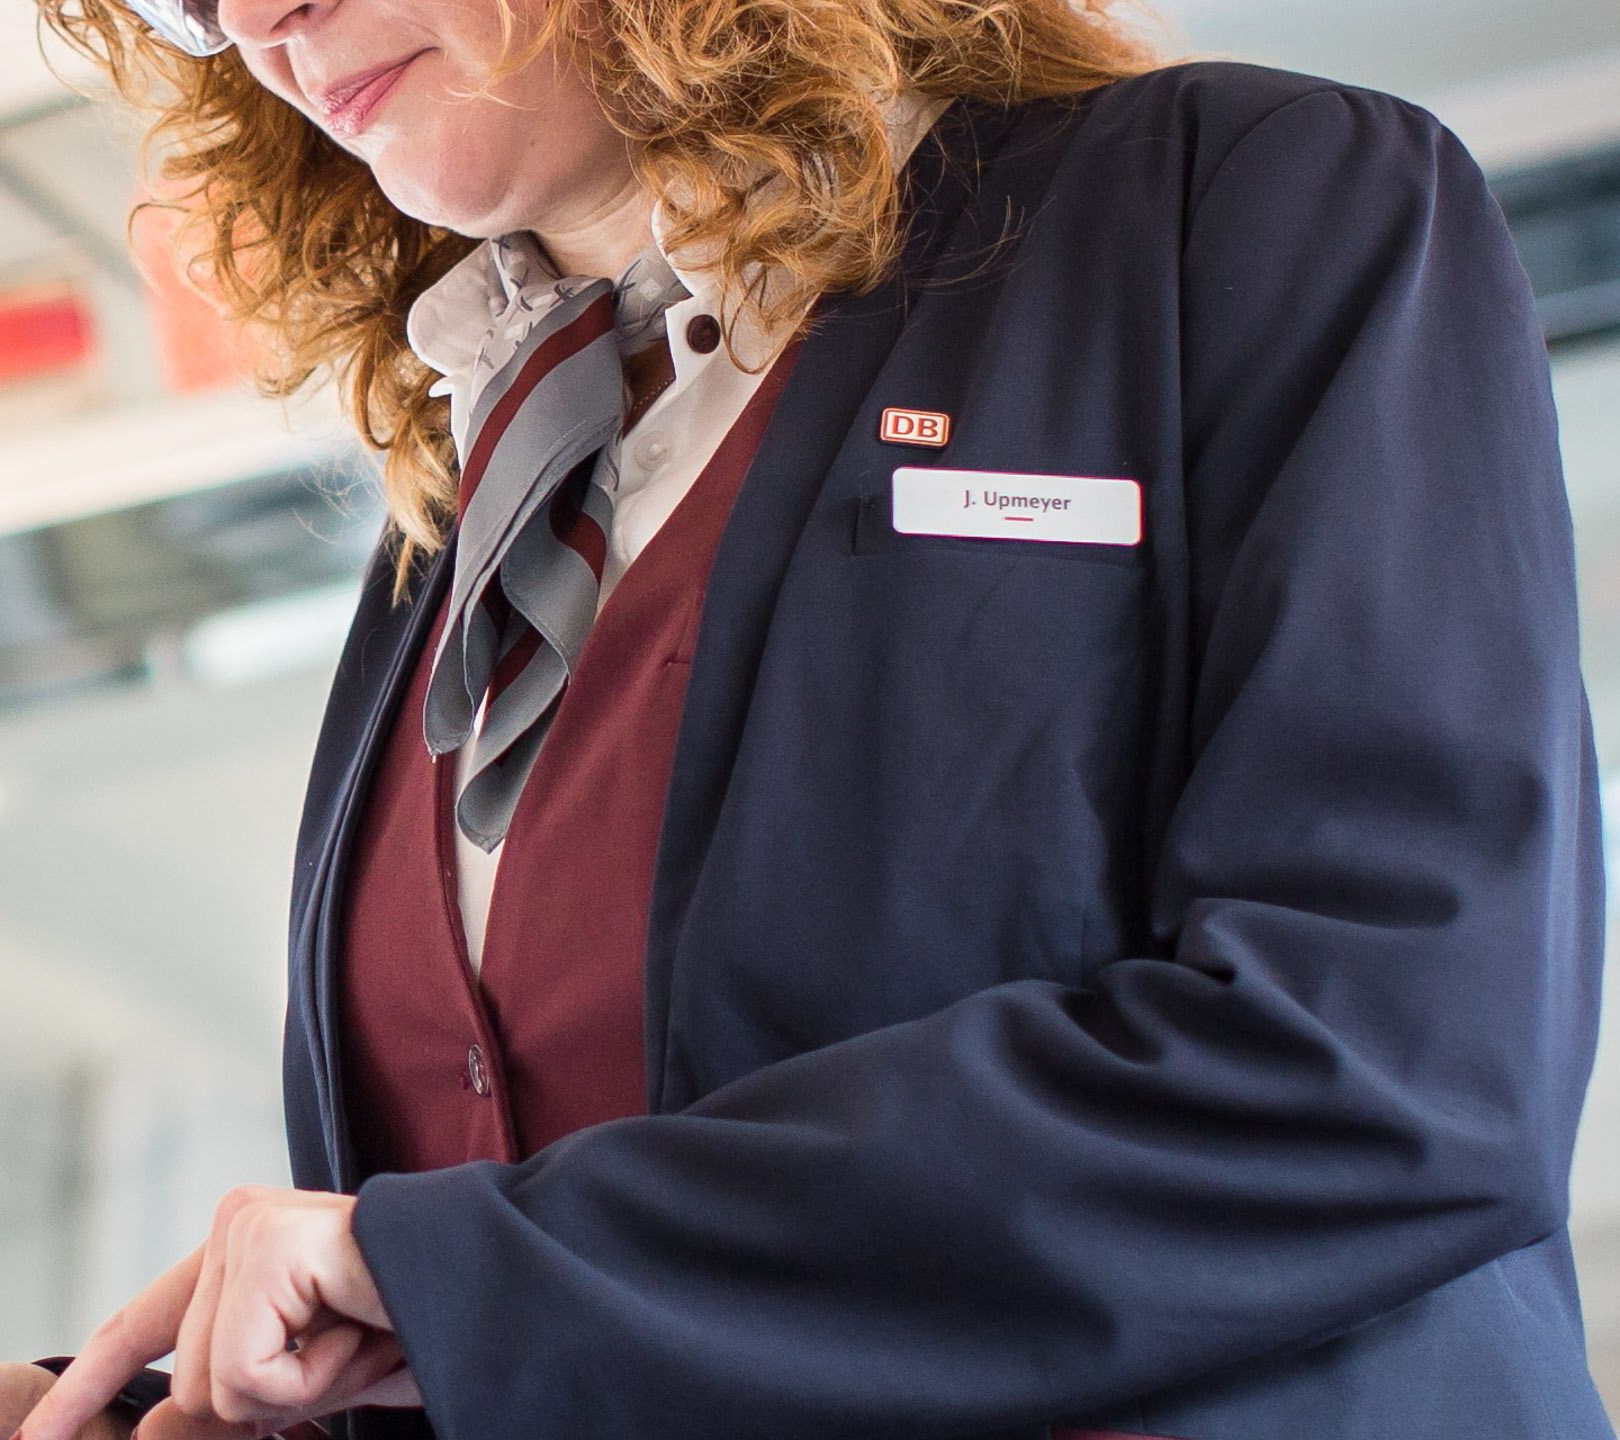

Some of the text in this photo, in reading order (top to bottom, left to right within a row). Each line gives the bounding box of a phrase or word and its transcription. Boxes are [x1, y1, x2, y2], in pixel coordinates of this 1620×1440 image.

[892, 415, 938, 438] DB
[964, 490, 1072, 513] J. Upmeyer
